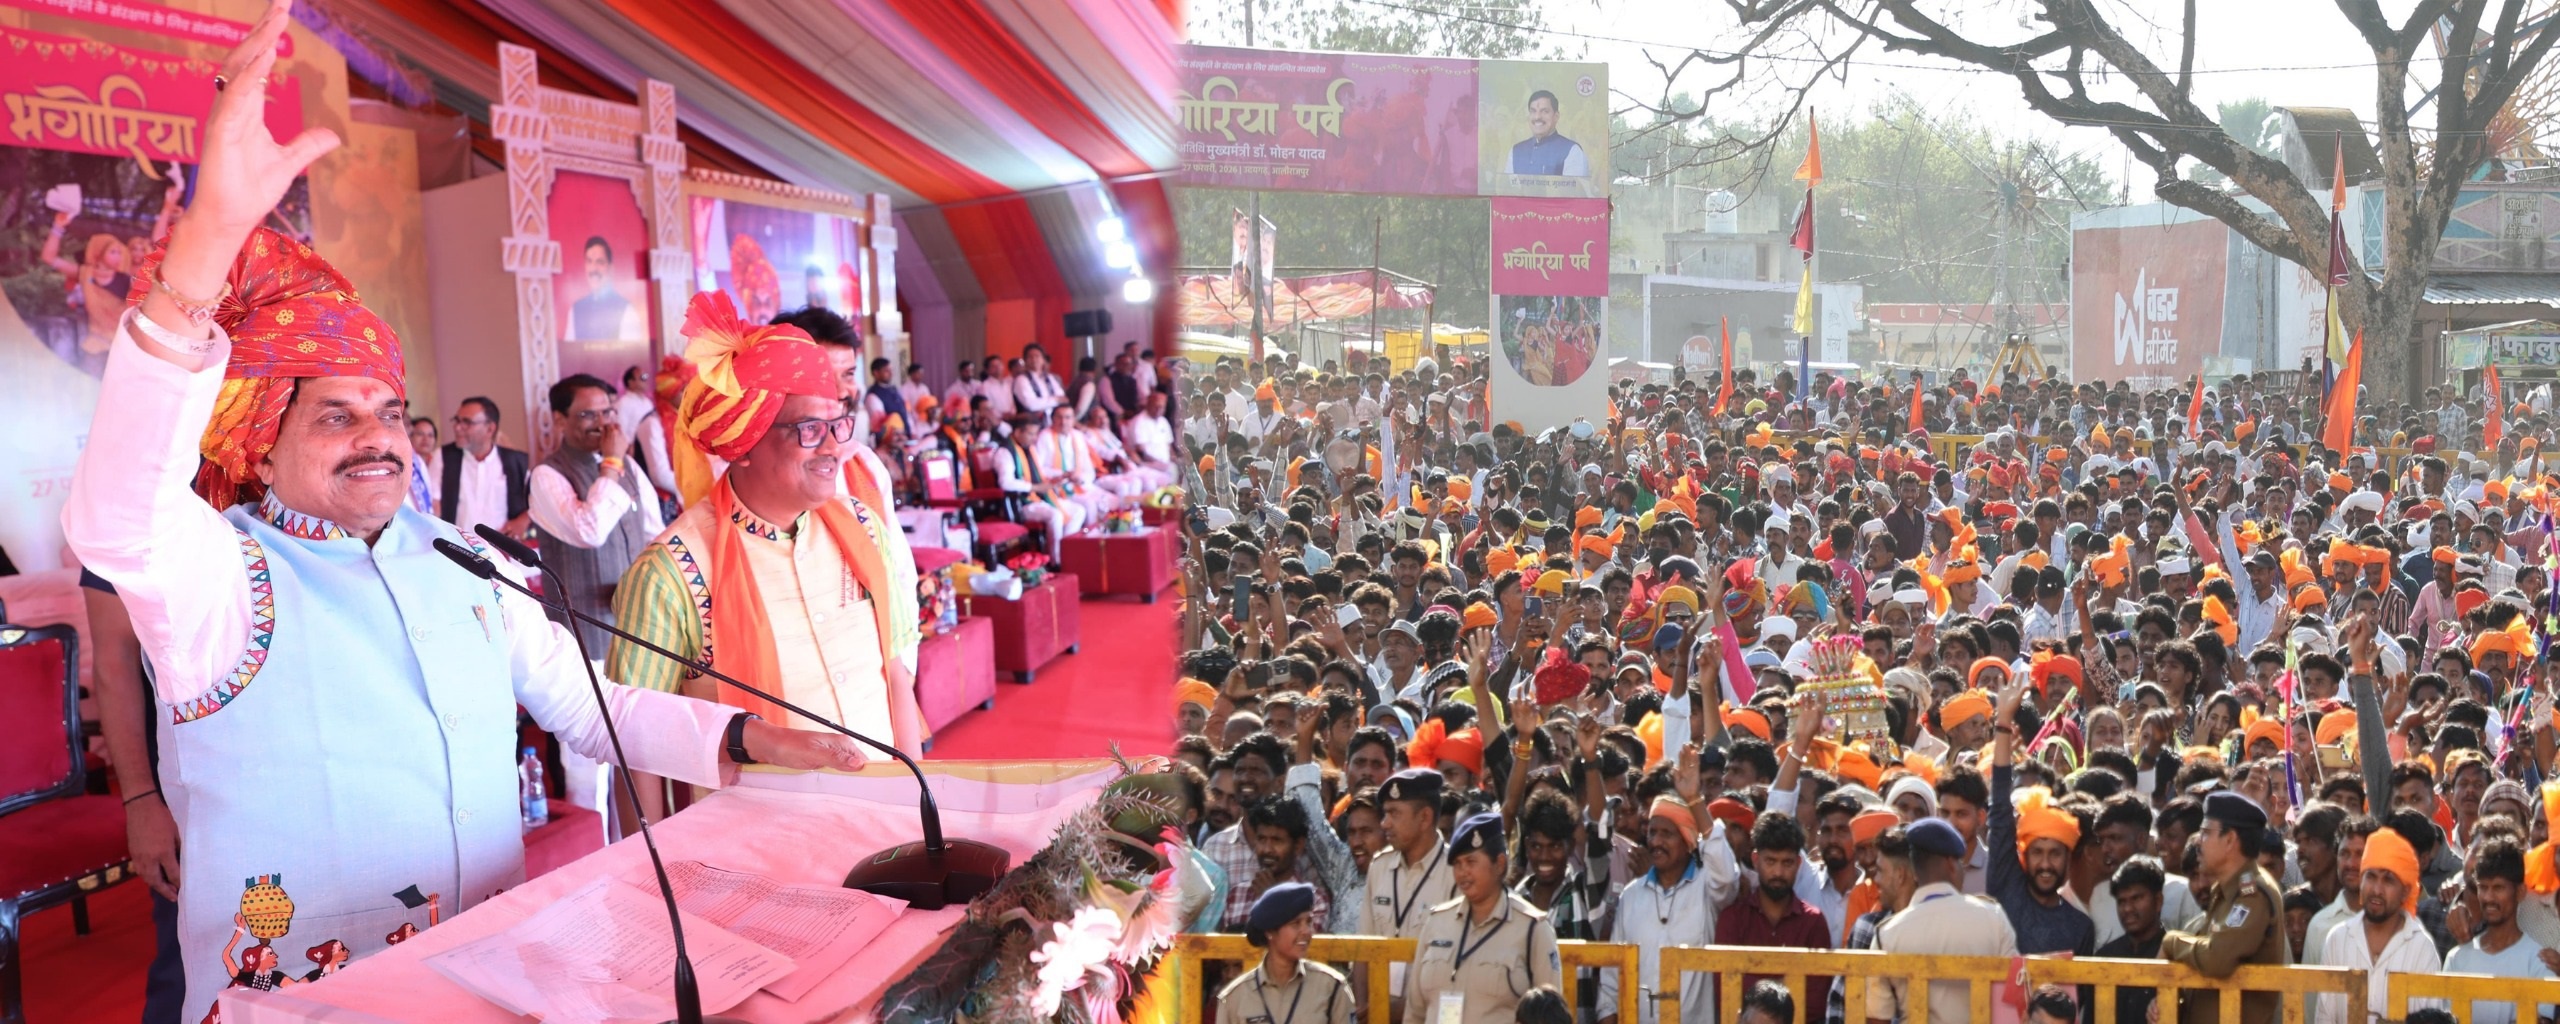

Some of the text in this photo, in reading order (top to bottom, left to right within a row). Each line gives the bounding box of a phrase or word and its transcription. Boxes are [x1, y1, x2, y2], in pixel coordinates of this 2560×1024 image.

[4, 75, 197, 181] भगोरिया
[1173, 76, 1355, 142] गोरिया पर्व
[1206, 142, 1250, 160] मुख्यमंत्री
[1252, 144, 1267, 158] डॉ.
[1269, 144, 1296, 159] मोहन
[1298, 148, 1326, 160] यादव
[1219, 165, 1238, 174] 2026
[1503, 240, 1595, 280] भगोरिया पर्व
[2147, 277, 2179, 322] वंडर
[1684, 343, 1711, 365] Madhuri
[2146, 327, 2178, 365] सीमेंट
